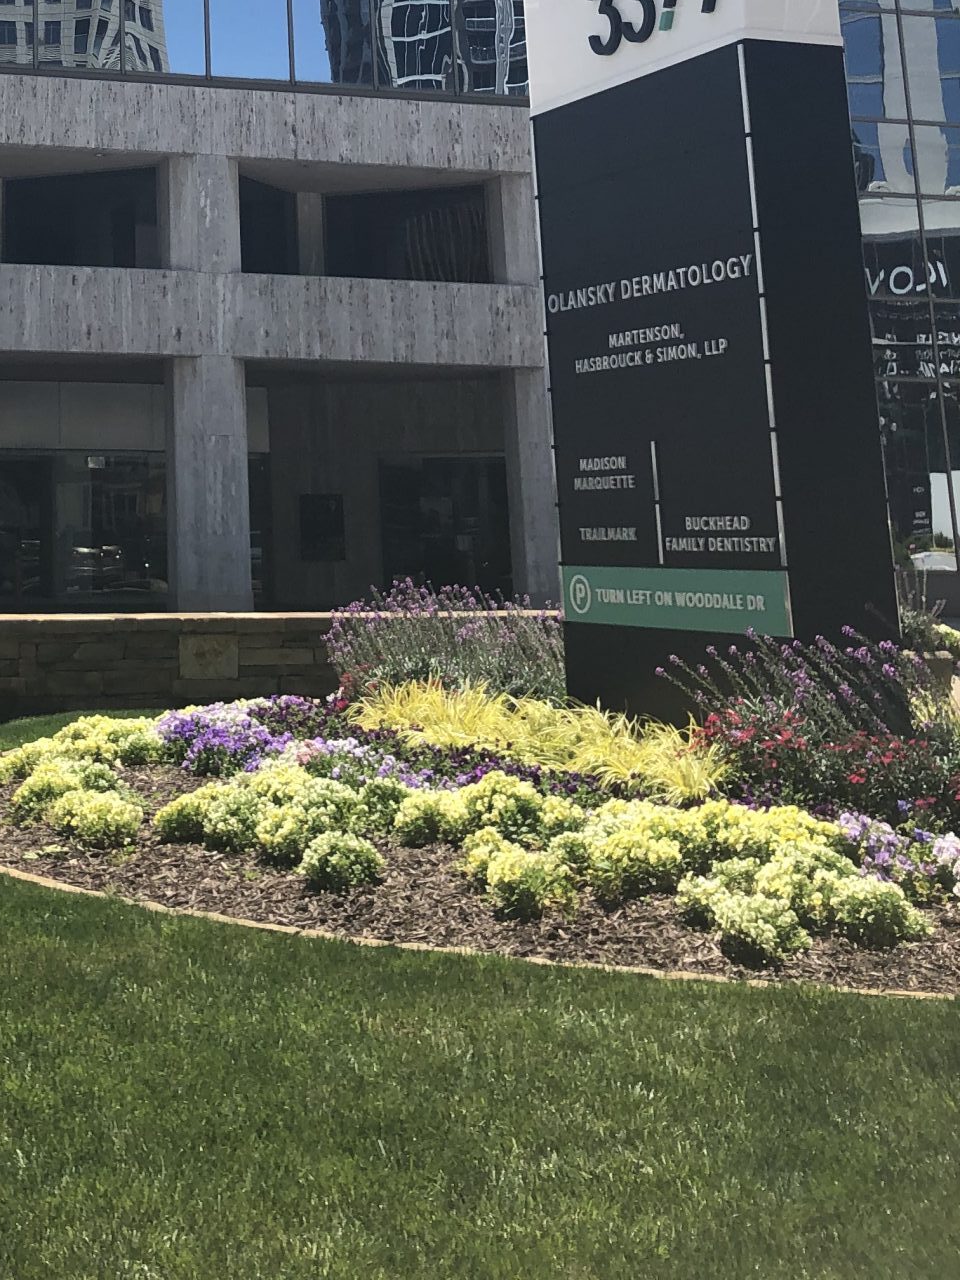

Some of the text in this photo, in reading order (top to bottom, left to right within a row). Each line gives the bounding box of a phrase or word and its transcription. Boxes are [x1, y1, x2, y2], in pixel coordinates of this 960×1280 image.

[547, 254, 753, 313] OLANSKY DERMATOLOGY
[608, 323, 685, 348] MARTENSON,
[575, 338, 728, 374] HASBROUCK & SIMON, LLP
[579, 456, 627, 471] MADISON
[574, 475, 636, 490] MARQUETTE
[685, 516, 750, 531] BUCKHEAD
[579, 527, 638, 541] TRAILMARK
[665, 537, 776, 552] FAMILY DENTISTRY
[595, 588, 624, 604] TURN
[626, 589, 653, 605] LEFT
[654, 590, 672, 606] ON
[674, 591, 744, 610] WOODDALE
[747, 595, 765, 611] DR
